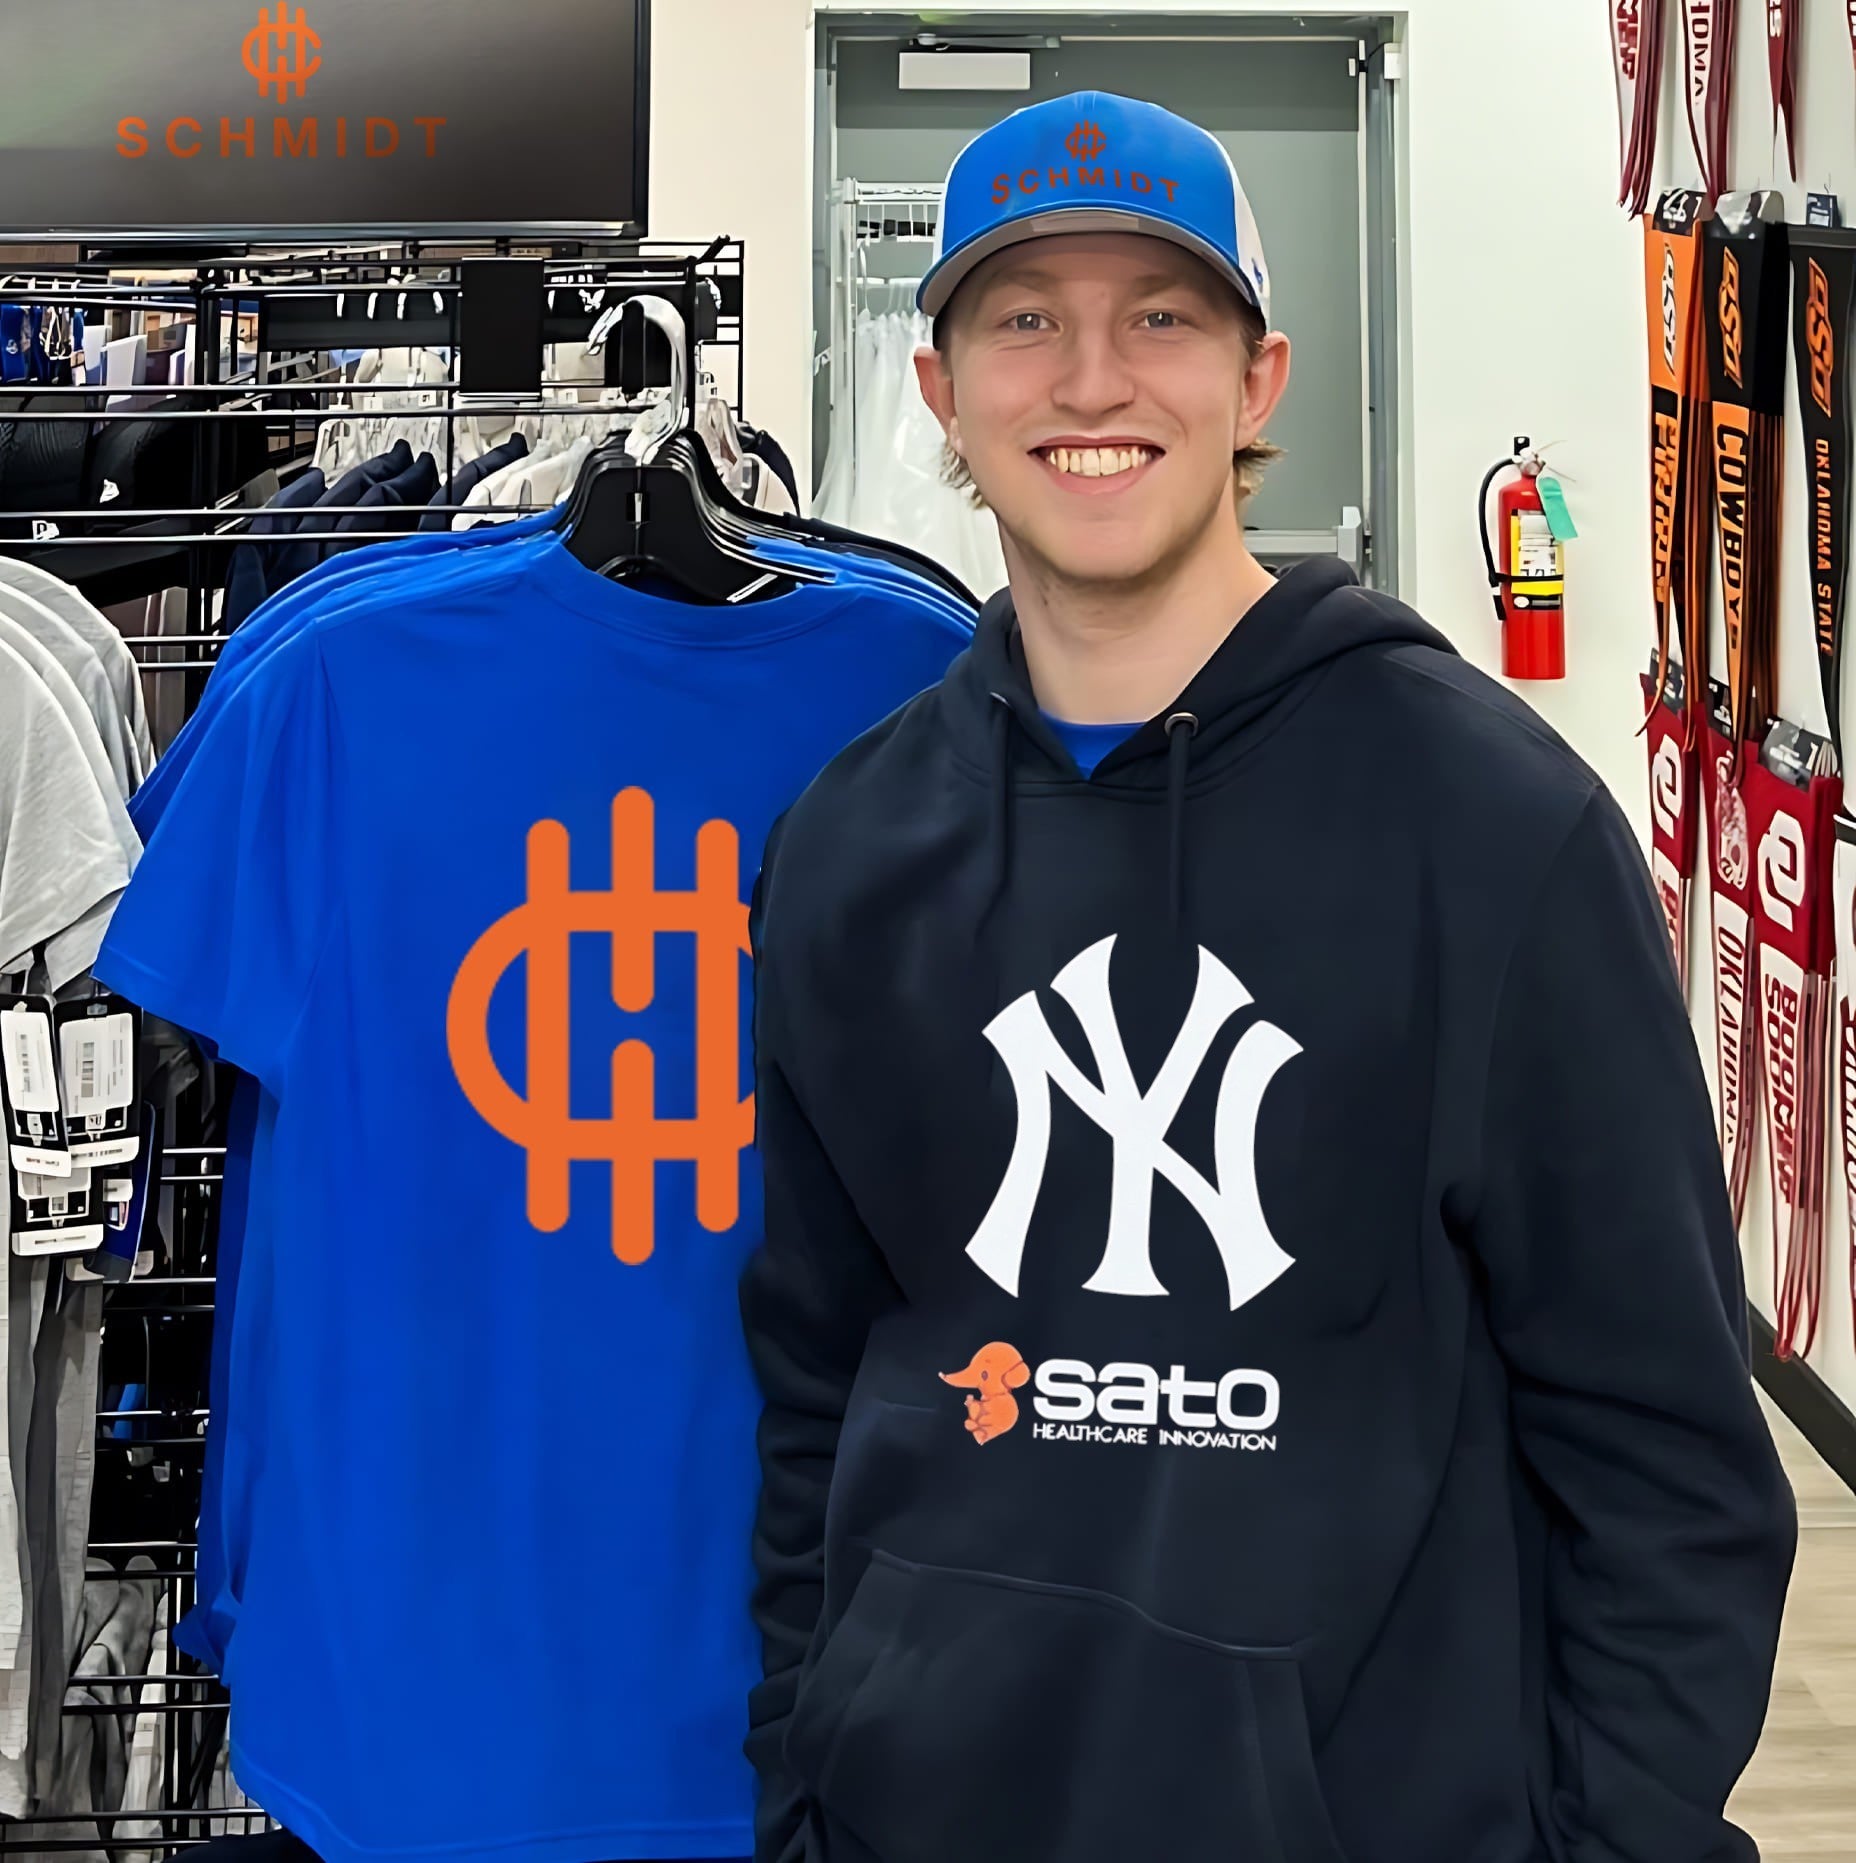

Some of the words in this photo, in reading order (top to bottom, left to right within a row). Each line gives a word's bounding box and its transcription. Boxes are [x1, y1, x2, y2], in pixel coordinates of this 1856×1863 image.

[115, 117, 447, 158] SCHMIDT
[991, 167, 1179, 204] SCHMIDT
[1815, 438, 1832, 570] OKLAHOMA
[1718, 925, 1744, 1144] OKLAHOMA
[965, 933, 1304, 1312] NY
[1033, 1358, 1280, 1430] sato
[1033, 1423, 1148, 1445] HEALTHCARE
[1159, 1429, 1277, 1451] INNOVATION
